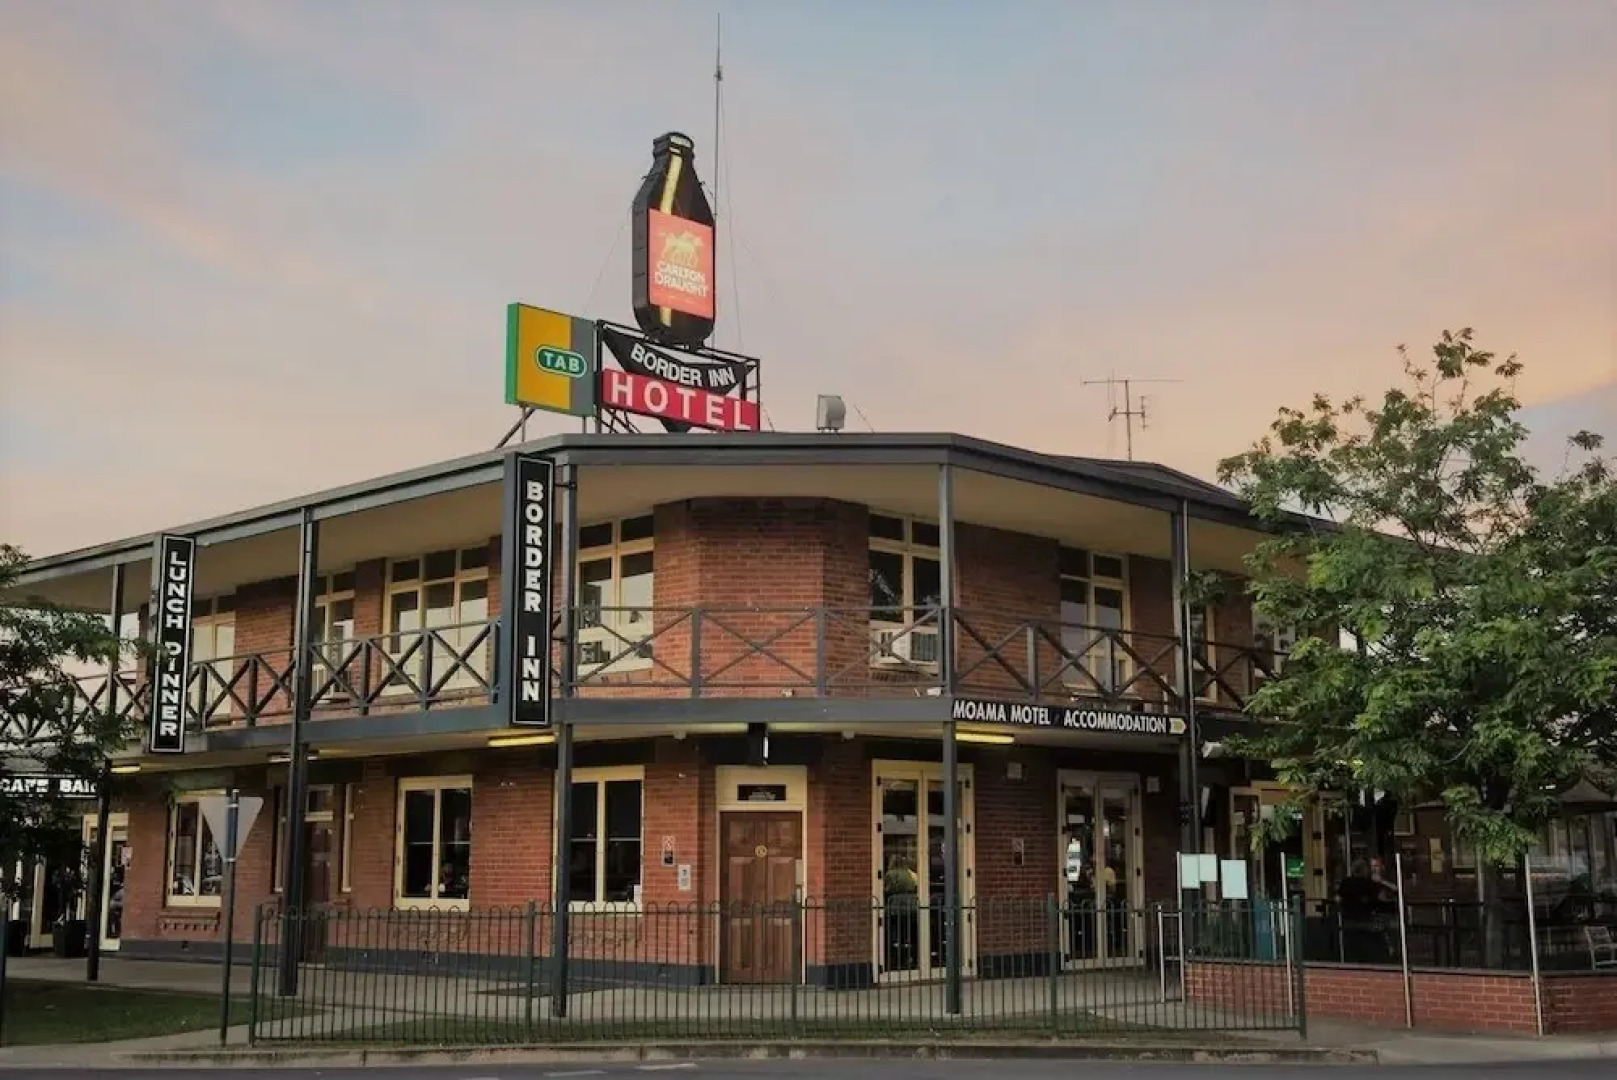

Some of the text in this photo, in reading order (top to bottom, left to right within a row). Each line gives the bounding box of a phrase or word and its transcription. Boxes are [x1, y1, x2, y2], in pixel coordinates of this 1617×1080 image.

[544, 353, 581, 372] TAB
[631, 343, 736, 387] BORDER INN
[611, 372, 751, 430] HOTEL
[522, 480, 544, 702] BORDER INN
[160, 550, 187, 736] LUNCH DINNER
[953, 700, 1166, 733] MOAMA MOTEL ACCOMMODATION
